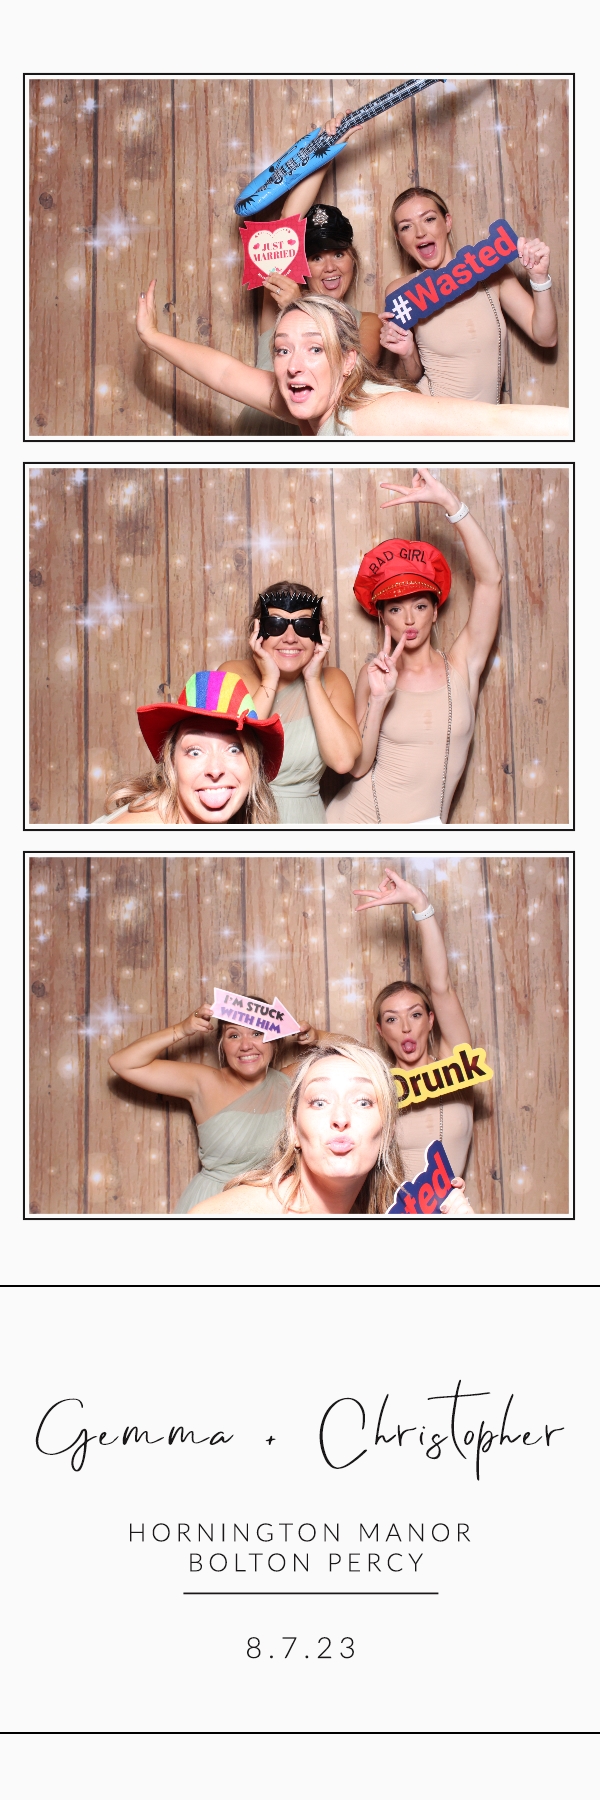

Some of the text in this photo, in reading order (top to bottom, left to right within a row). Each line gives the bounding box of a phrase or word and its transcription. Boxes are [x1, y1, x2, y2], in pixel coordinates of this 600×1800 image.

[253, 249, 296, 261] MARRIED
[262, 241, 284, 251] JUST
[392, 226, 517, 324] #Wasted
[369, 548, 427, 575] BAD GIRL
[220, 1006, 281, 1034] WITH HIM
[223, 994, 285, 1021] I'M STUCK
[402, 1151, 451, 1214] ted
